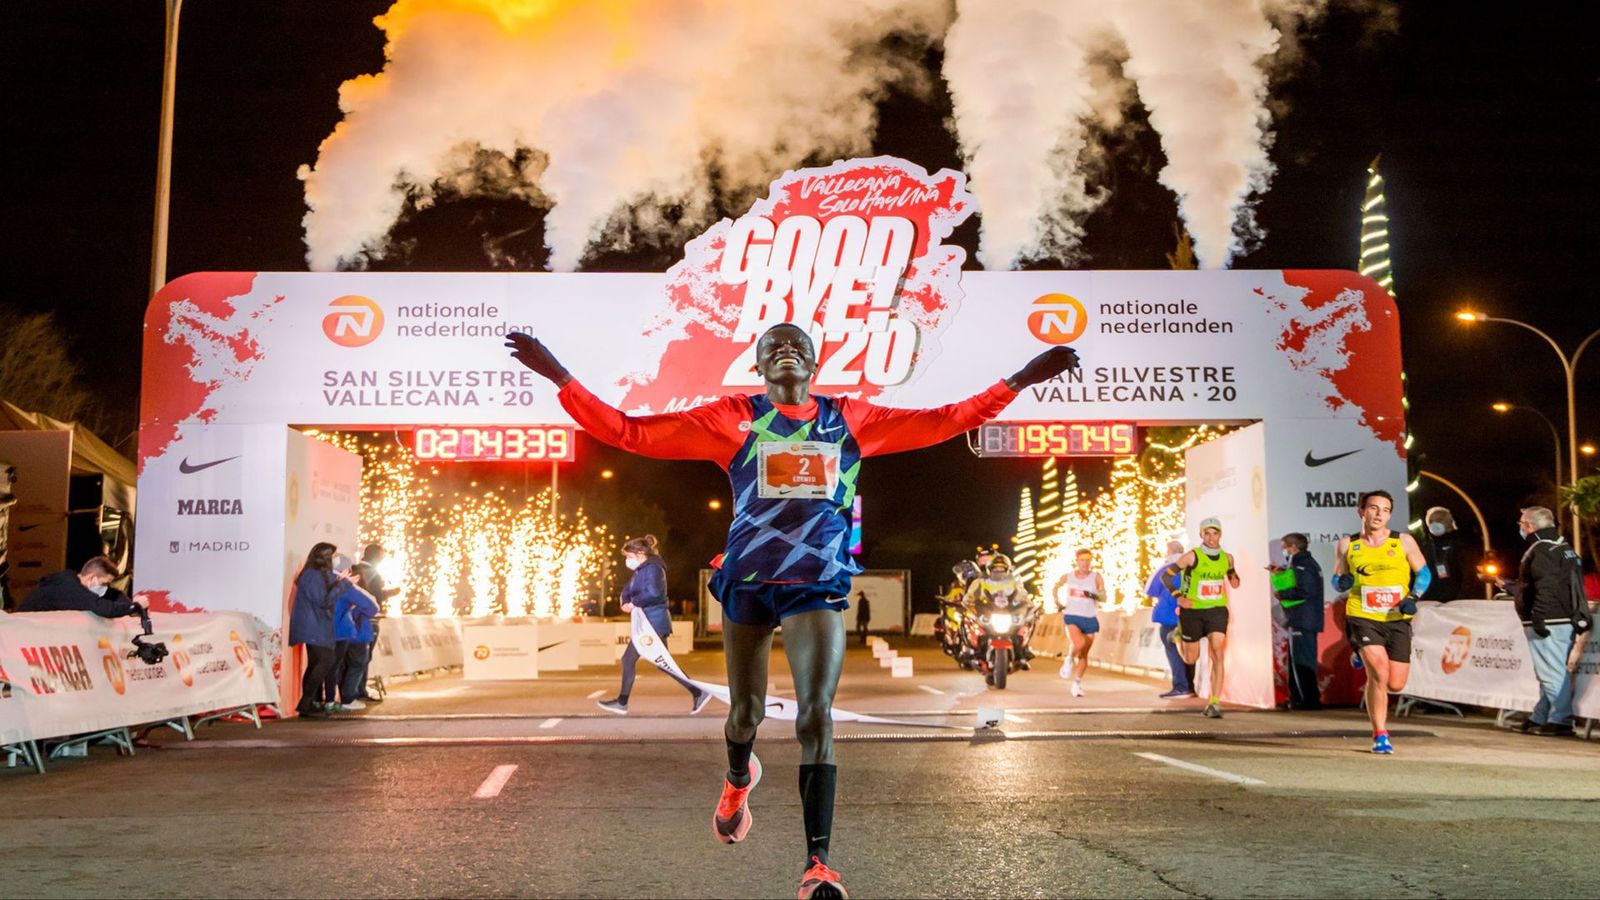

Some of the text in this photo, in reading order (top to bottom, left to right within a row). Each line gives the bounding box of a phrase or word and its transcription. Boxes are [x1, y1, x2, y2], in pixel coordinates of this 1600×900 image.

[720, 215, 915, 285] GOOD
[397, 302, 498, 318] nationale
[1100, 300, 1199, 315] nationale
[1100, 318, 1234, 334] nederlanden
[323, 370, 534, 387] SAN SILVESTRE
[1094, 367, 1236, 384] SILVESTRE
[323, 390, 534, 406] VALLECANA 20
[1032, 385, 1237, 403] VALLECANA 20
[798, 457, 810, 475] 2
[177, 499, 244, 515] MARCA
[1305, 491, 1362, 508] MARC
[189, 541, 250, 552] MADRID
[1375, 593, 1394, 603] 240
